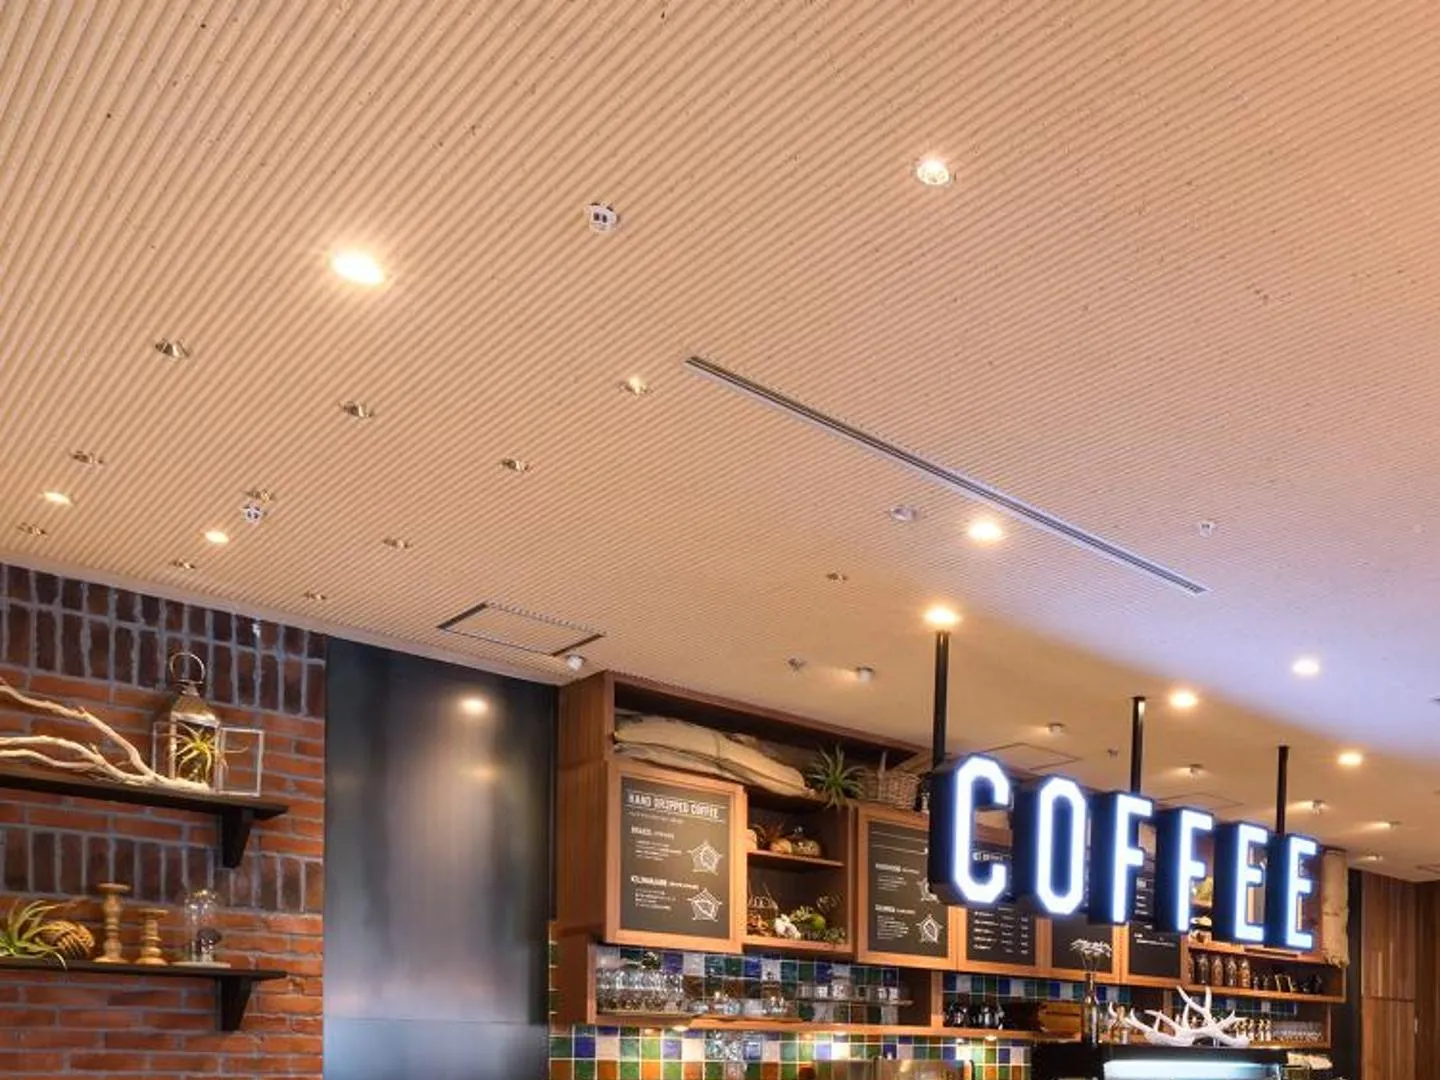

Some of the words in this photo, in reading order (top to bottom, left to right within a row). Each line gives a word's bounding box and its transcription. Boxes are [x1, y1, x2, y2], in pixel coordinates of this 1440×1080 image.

[628, 794, 651, 807] HAND
[654, 797, 689, 813] DRIPPED
[690, 802, 719, 818] COFFEE
[953, 756, 1317, 948] COFFEE
